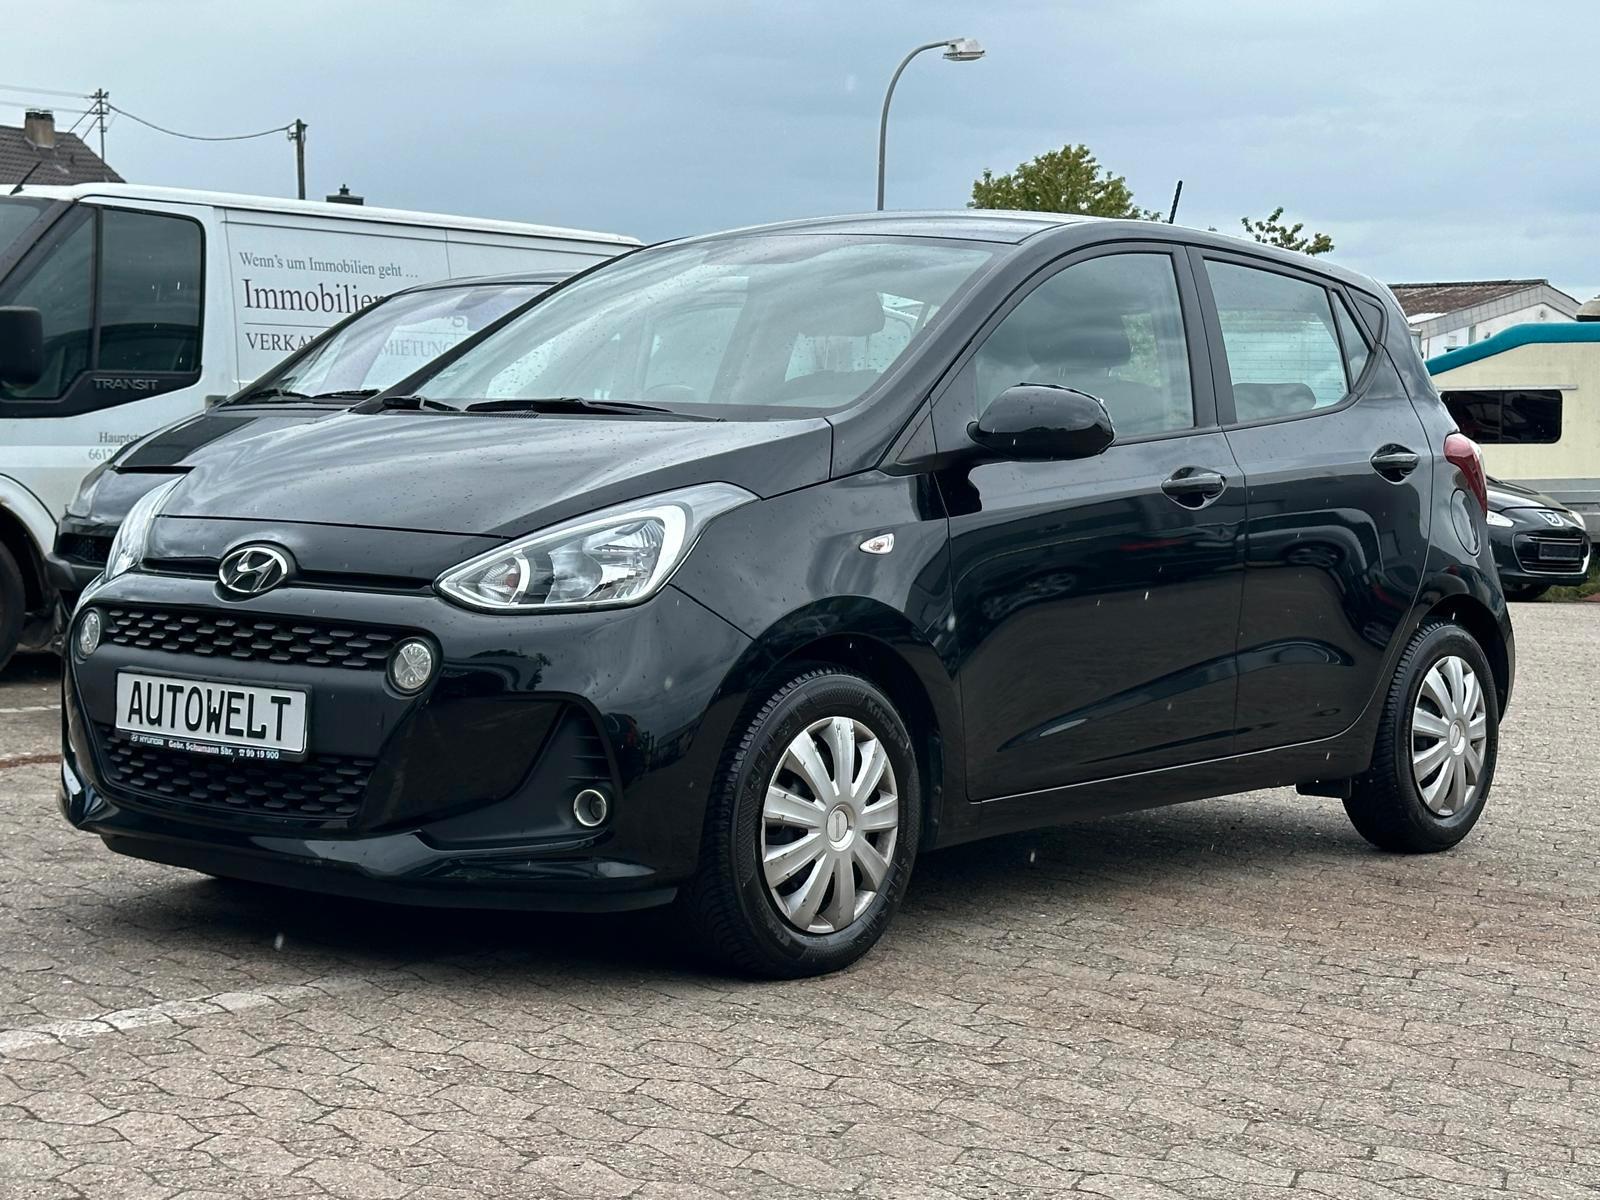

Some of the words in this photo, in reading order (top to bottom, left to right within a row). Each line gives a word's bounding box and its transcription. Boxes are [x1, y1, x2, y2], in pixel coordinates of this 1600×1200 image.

[239, 252, 284, 269] Wenn's
[286, 259, 305, 271] um
[309, 257, 375, 275] Immobilien
[378, 264, 402, 279] geht
[246, 332, 316, 352] VERKA
[93, 378, 158, 391] TRANSIT
[88, 448, 117, 460] 6612
[127, 680, 292, 741] AUTOWELT
[266, 750, 279, 760] 900
